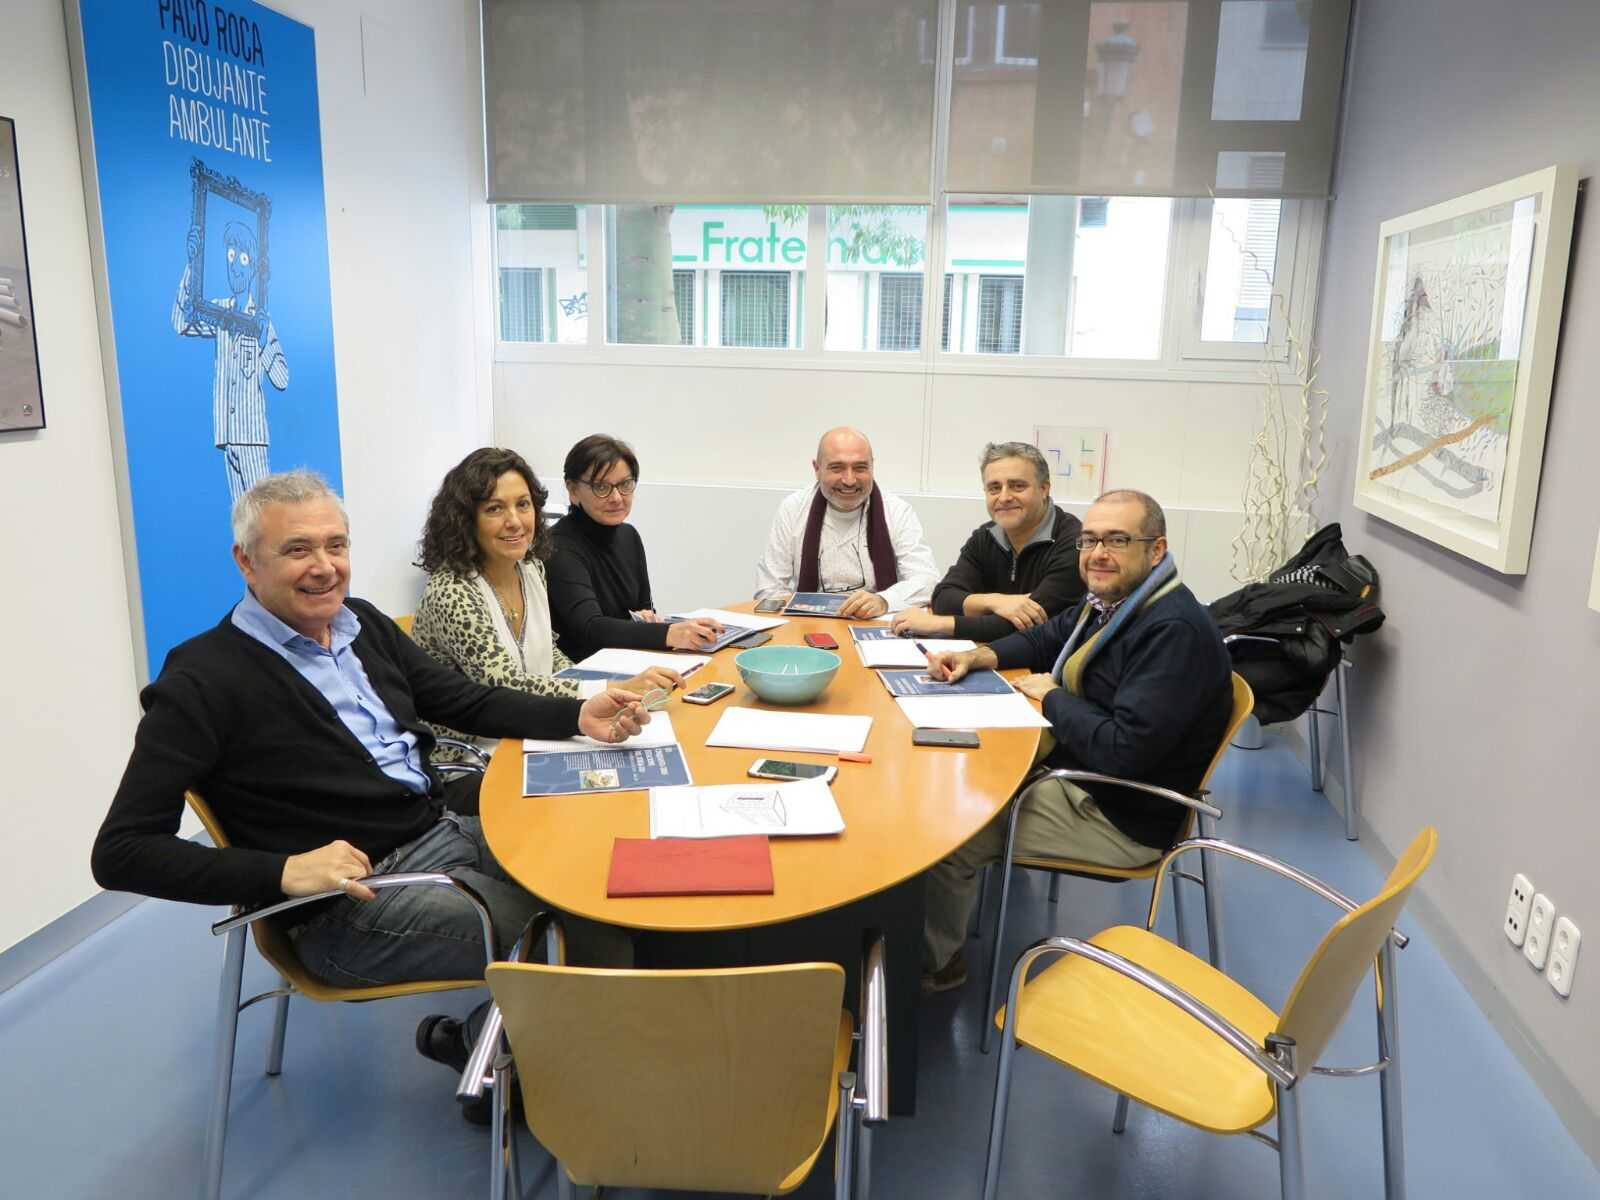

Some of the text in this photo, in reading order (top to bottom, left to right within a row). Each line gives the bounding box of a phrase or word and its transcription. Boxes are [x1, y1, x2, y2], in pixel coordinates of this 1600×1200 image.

[159, 0, 265, 67] PACO ROCA
[163, 40, 269, 116] DIBUJANTE
[169, 94, 272, 162] AMBULANTE
